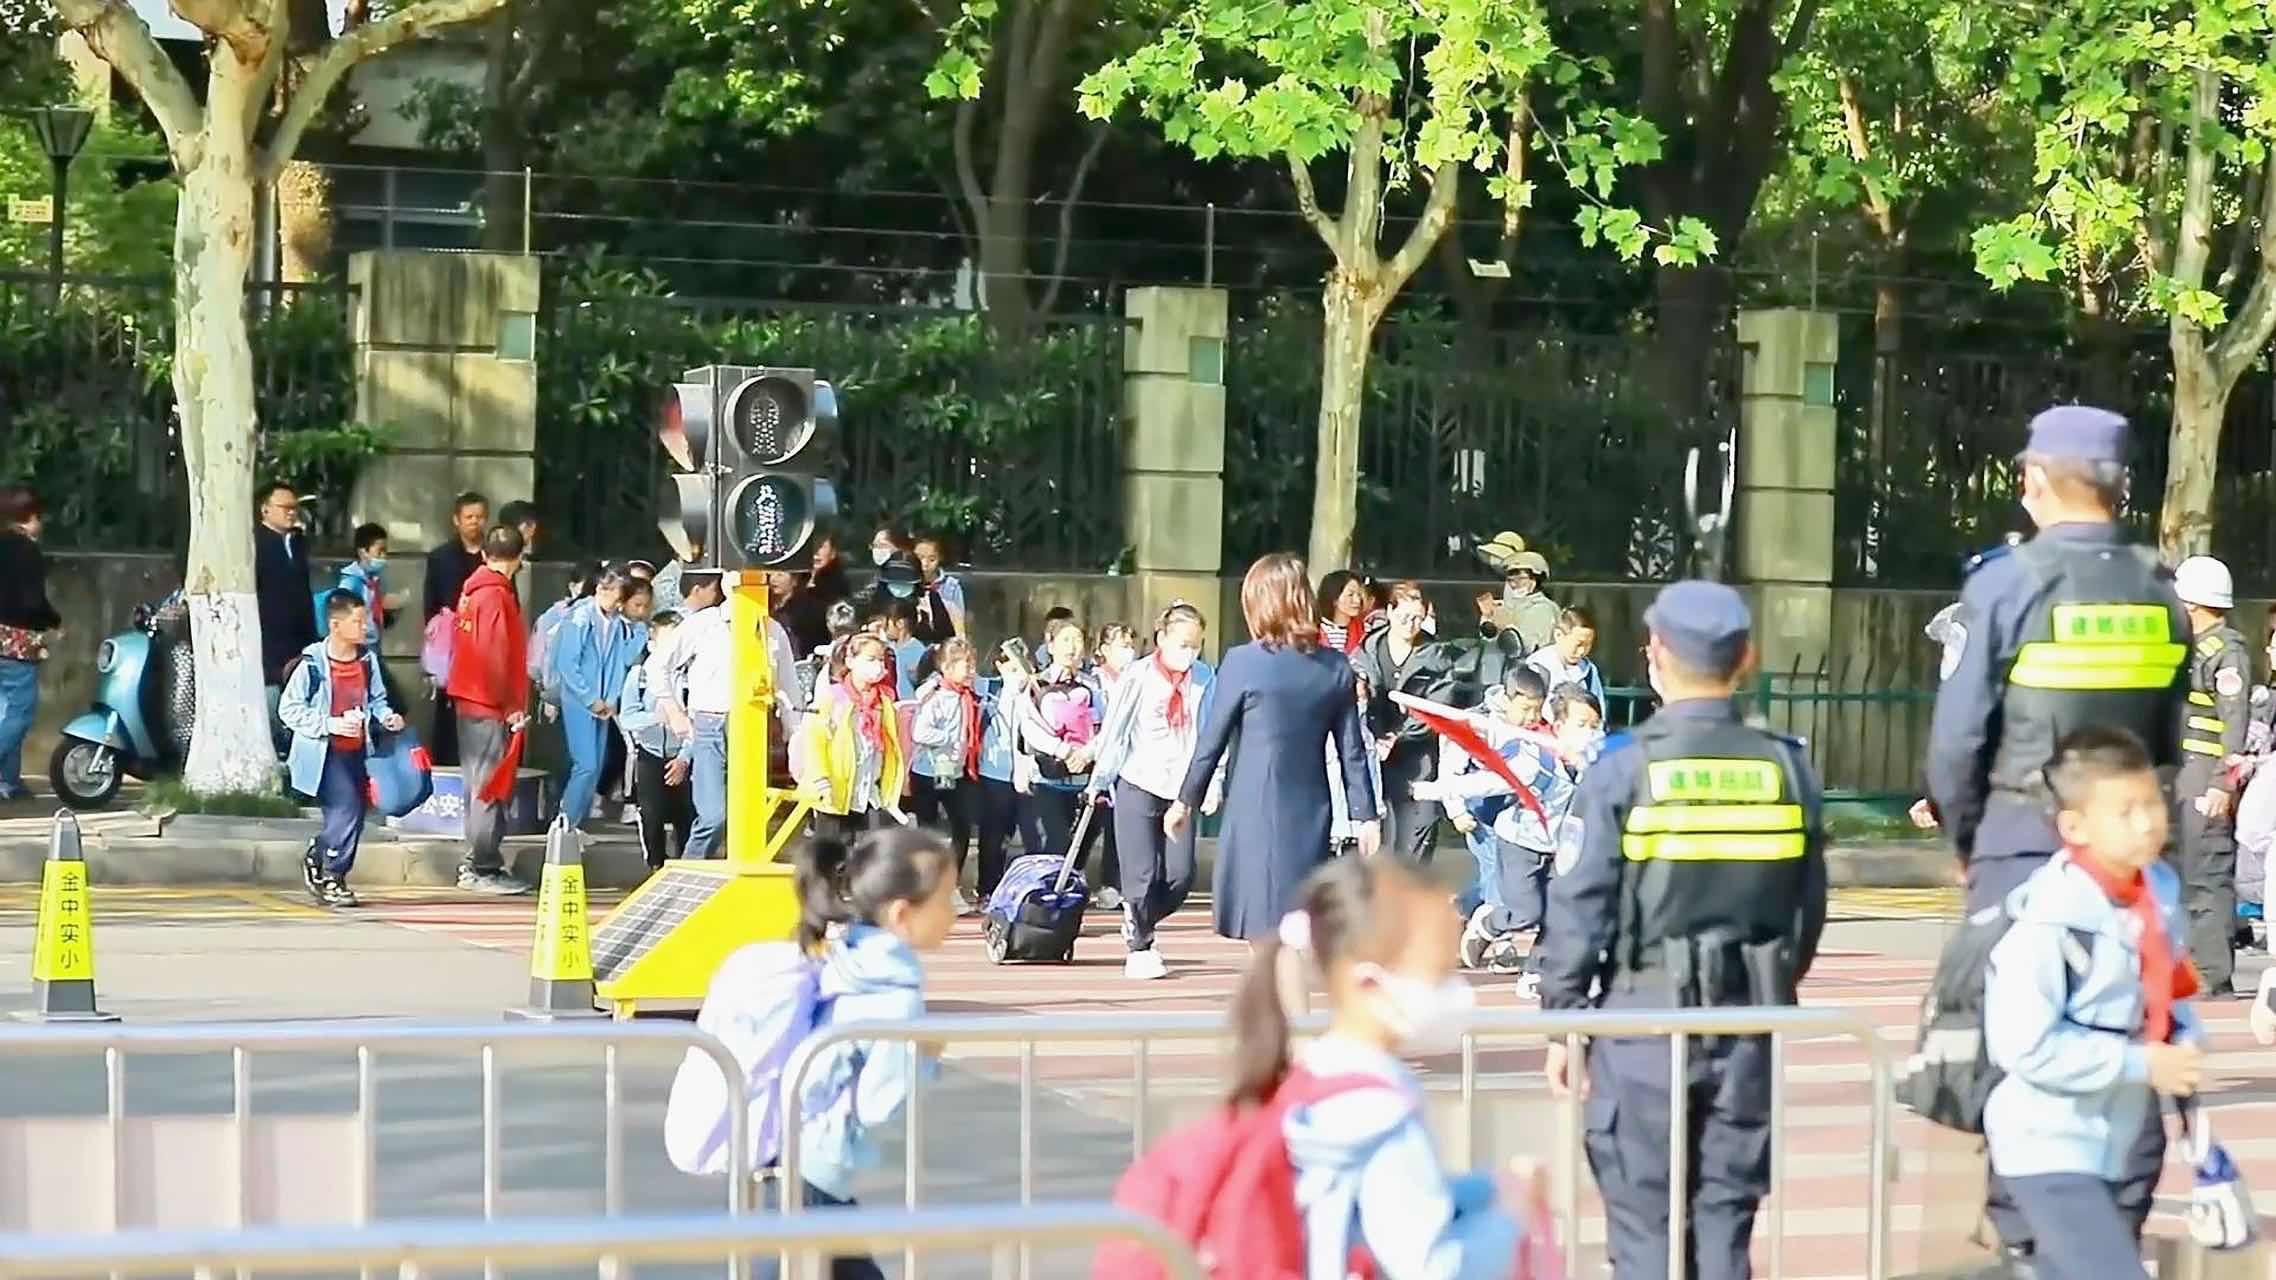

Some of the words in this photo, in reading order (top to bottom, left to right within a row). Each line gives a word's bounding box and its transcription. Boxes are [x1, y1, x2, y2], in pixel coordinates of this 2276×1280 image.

[421, 793, 465, 818] 公安
[60, 871, 80, 969] 金中实小
[562, 875, 580, 968] 金中实小
